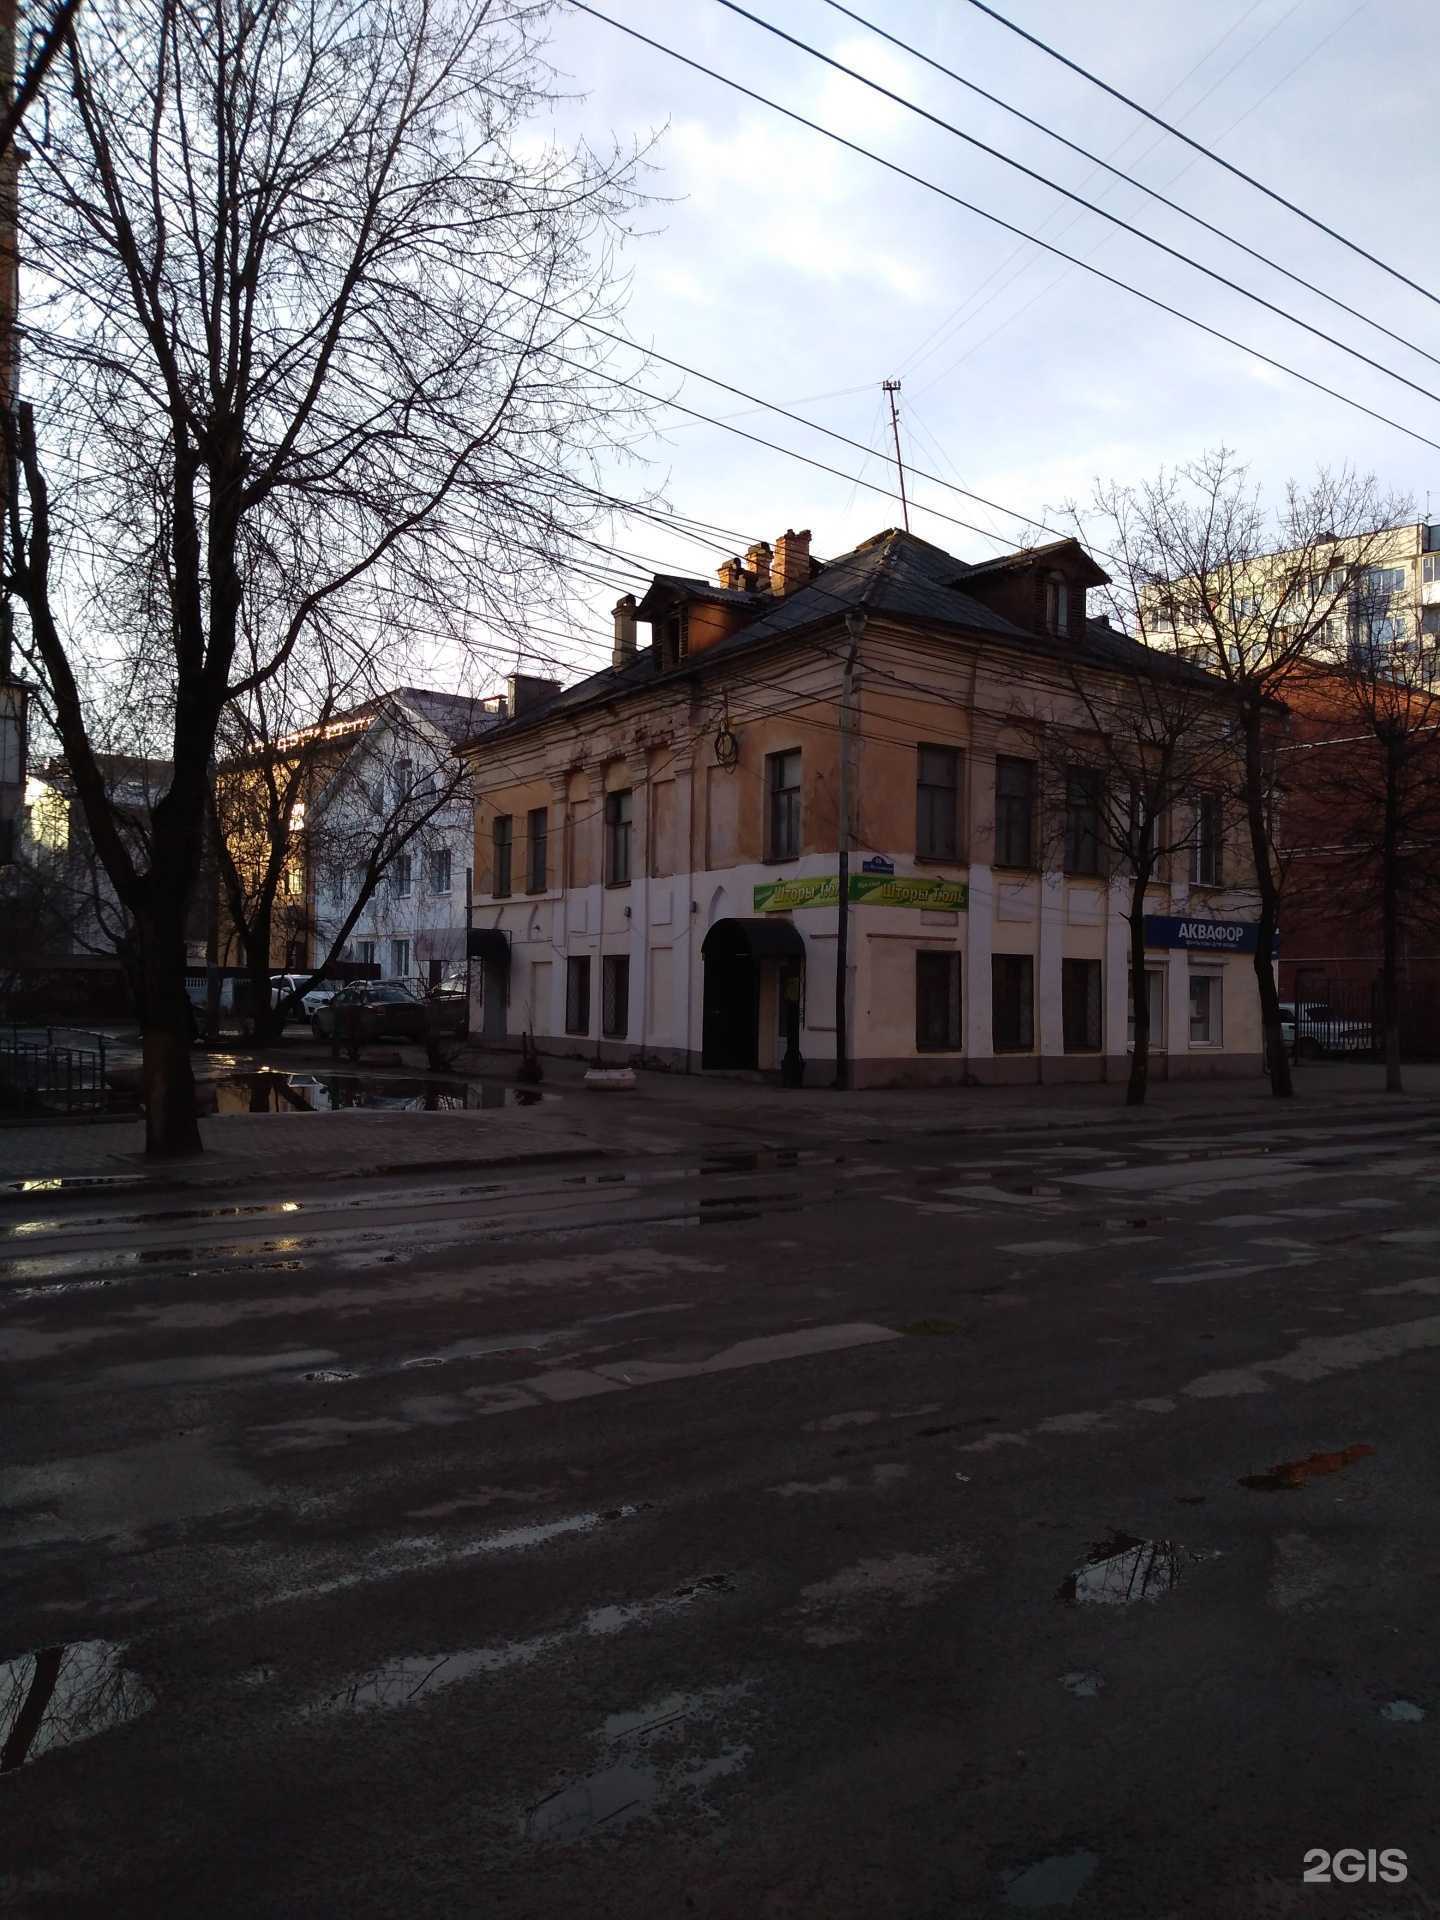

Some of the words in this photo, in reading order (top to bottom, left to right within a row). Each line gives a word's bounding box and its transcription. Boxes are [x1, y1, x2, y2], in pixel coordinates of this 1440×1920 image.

[773, 886, 812, 904] Шторы
[881, 883, 929, 902] Шторы
[933, 887, 966, 904] Тюль
[1178, 922, 1244, 942] АКВАФОР
